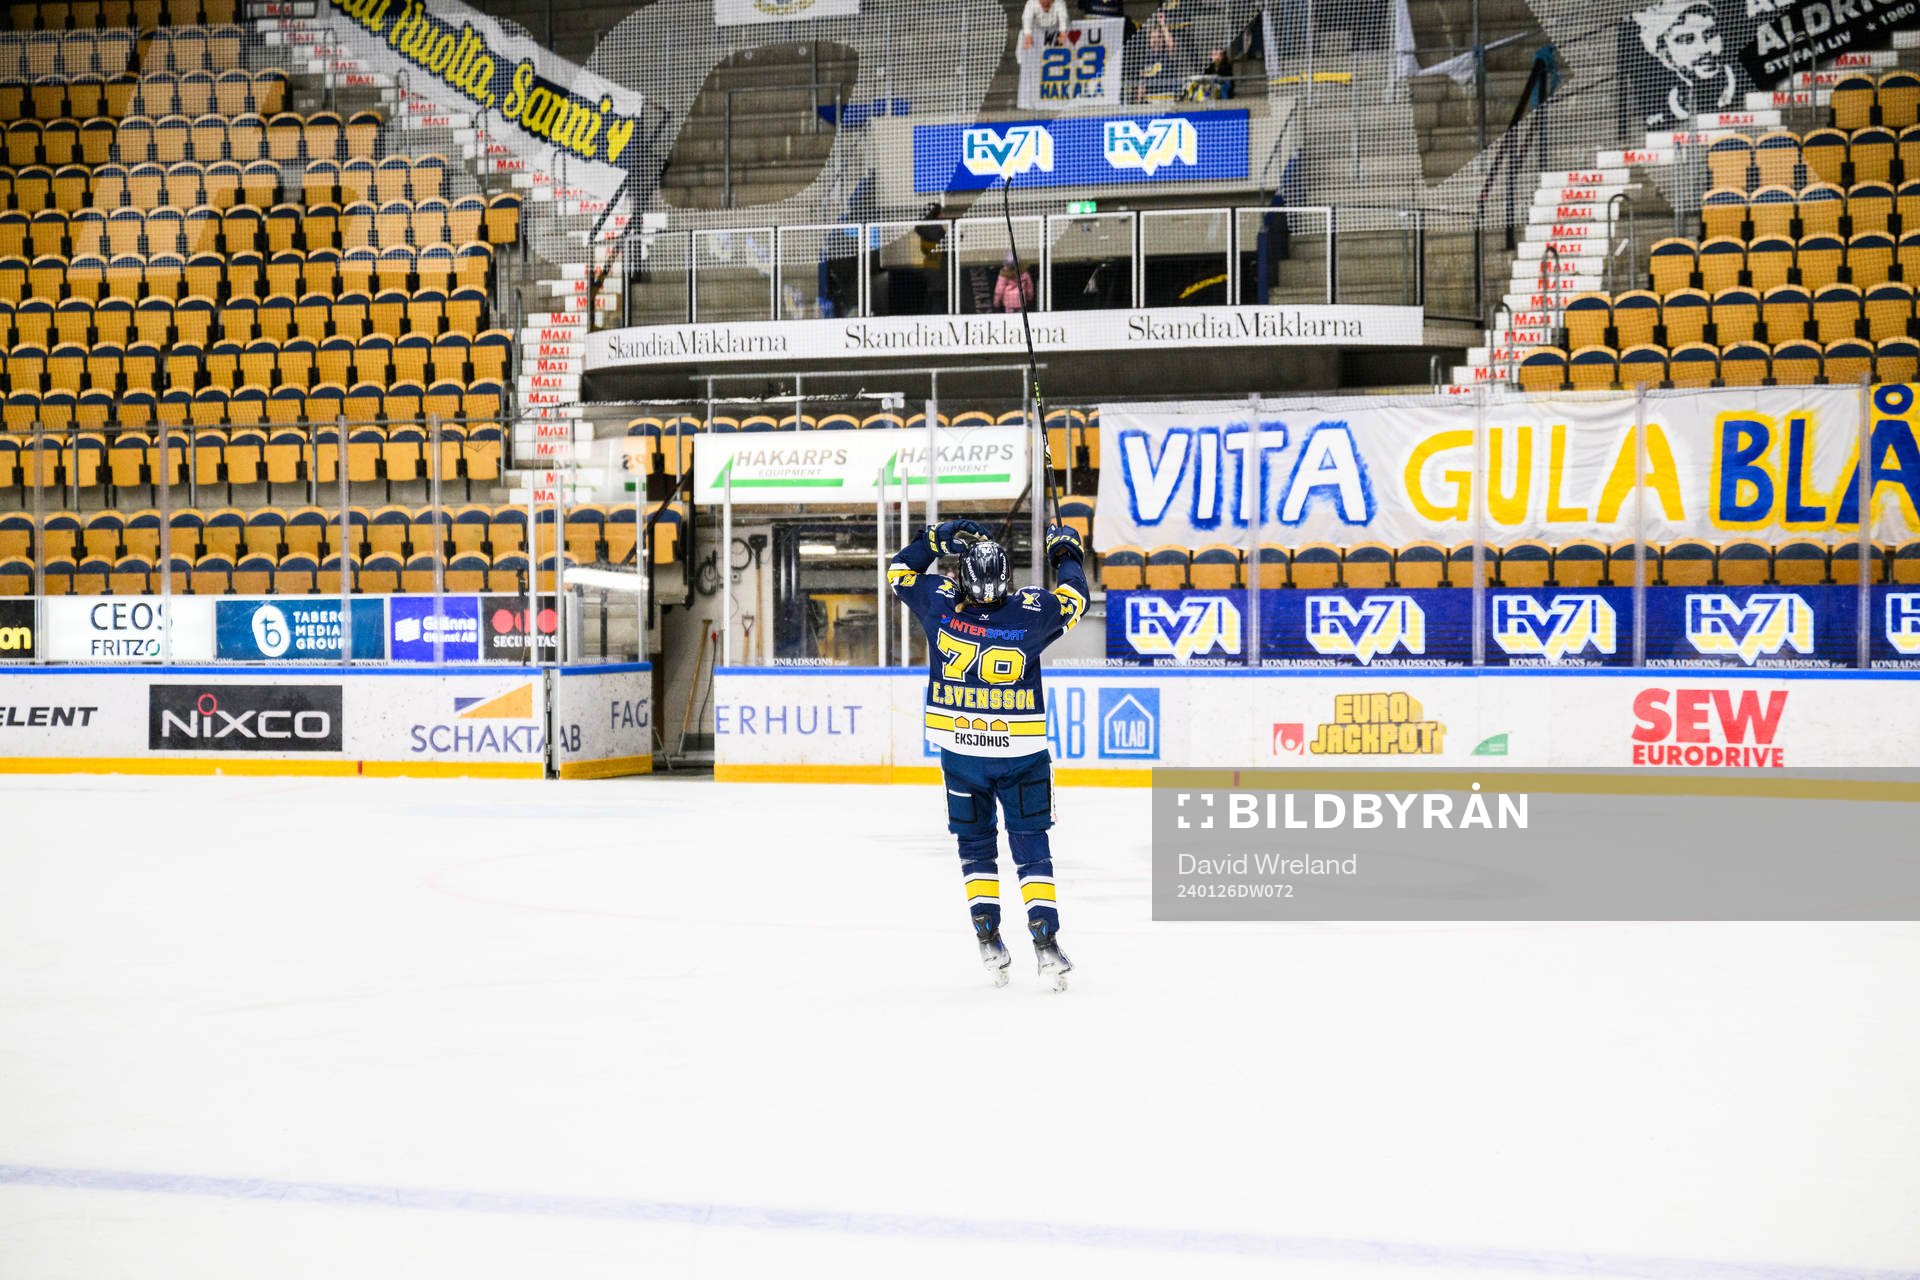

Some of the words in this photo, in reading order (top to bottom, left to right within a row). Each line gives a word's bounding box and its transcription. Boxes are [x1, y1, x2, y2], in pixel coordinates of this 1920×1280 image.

[1757, 0, 1896, 56] ALDR
[1826, 31, 1851, 49] LIV
[1879, 3, 1915, 25] 1980
[1088, 28, 1102, 44] U
[1042, 45, 1106, 82] 23
[1836, 54, 1871, 66] MAXI
[503, 63, 612, 157] Sanni
[963, 126, 1053, 174] HV71
[1104, 119, 1197, 170] HV71
[1552, 225, 1588, 237] MAXI
[576, 297, 606, 308] MXI
[550, 313, 580, 325] MAXI
[1128, 312, 1364, 342] SkandiaMäklarna
[1514, 313, 1551, 326] MAXI
[541, 329, 572, 341] MAXI
[845, 320, 1066, 351] SkandiaMäklarna
[1504, 331, 1541, 343] MAXI
[539, 345, 569, 356] MAXI
[608, 330, 787, 361] SkandiaMäklarna
[537, 360, 567, 372] MAXI
[1474, 367, 1507, 380] MAX
[531, 376, 561, 388] MAXI
[528, 393, 559, 404] MAXI
[537, 426, 568, 437] MAXI
[736, 449, 848, 466] HAKARPS
[900, 444, 1014, 463] HAKARPS
[1119, 421, 1377, 529] VITA
[1403, 424, 1685, 525] GULA
[1712, 383, 1920, 528] BLÅ
[758, 468, 822, 478] EQUIPMENT
[923, 465, 988, 475] EUIPMENT
[295, 624, 340, 636] MEDIA
[950, 618, 1025, 641] INTERSPORT
[1126, 597, 1240, 656] HV71
[1306, 596, 1424, 656] HV71
[1493, 595, 1616, 655] HV71
[1686, 594, 1814, 655] HV71
[91, 639, 168, 656] FRITZO
[493, 635, 558, 647] SECURTAS
[938, 628, 1026, 685] 70
[1154, 658, 1226, 667] KONDSSONS
[1262, 659, 1336, 668] KONRADSSONS
[1371, 659, 1446, 668] KONRADSSONS
[1509, 659, 1585, 668] KONRADSONS
[1646, 659, 1721, 669] KONRADSSONS
[1756, 659, 1831, 669] KONRADSSONS
[933, 682, 1035, 709] E.SVENSSON
[611, 699, 648, 729] FAG
[1335, 693, 1416, 722] EURO
[1632, 688, 1789, 744] SEW
[715, 705, 863, 735] ERHULT
[955, 731, 1010, 748] EKSJÖHUS
[1113, 720, 1146, 747] YLAB
[1310, 721, 1443, 754] JACKPOT
[1633, 745, 1784, 767] EURODRIVE
